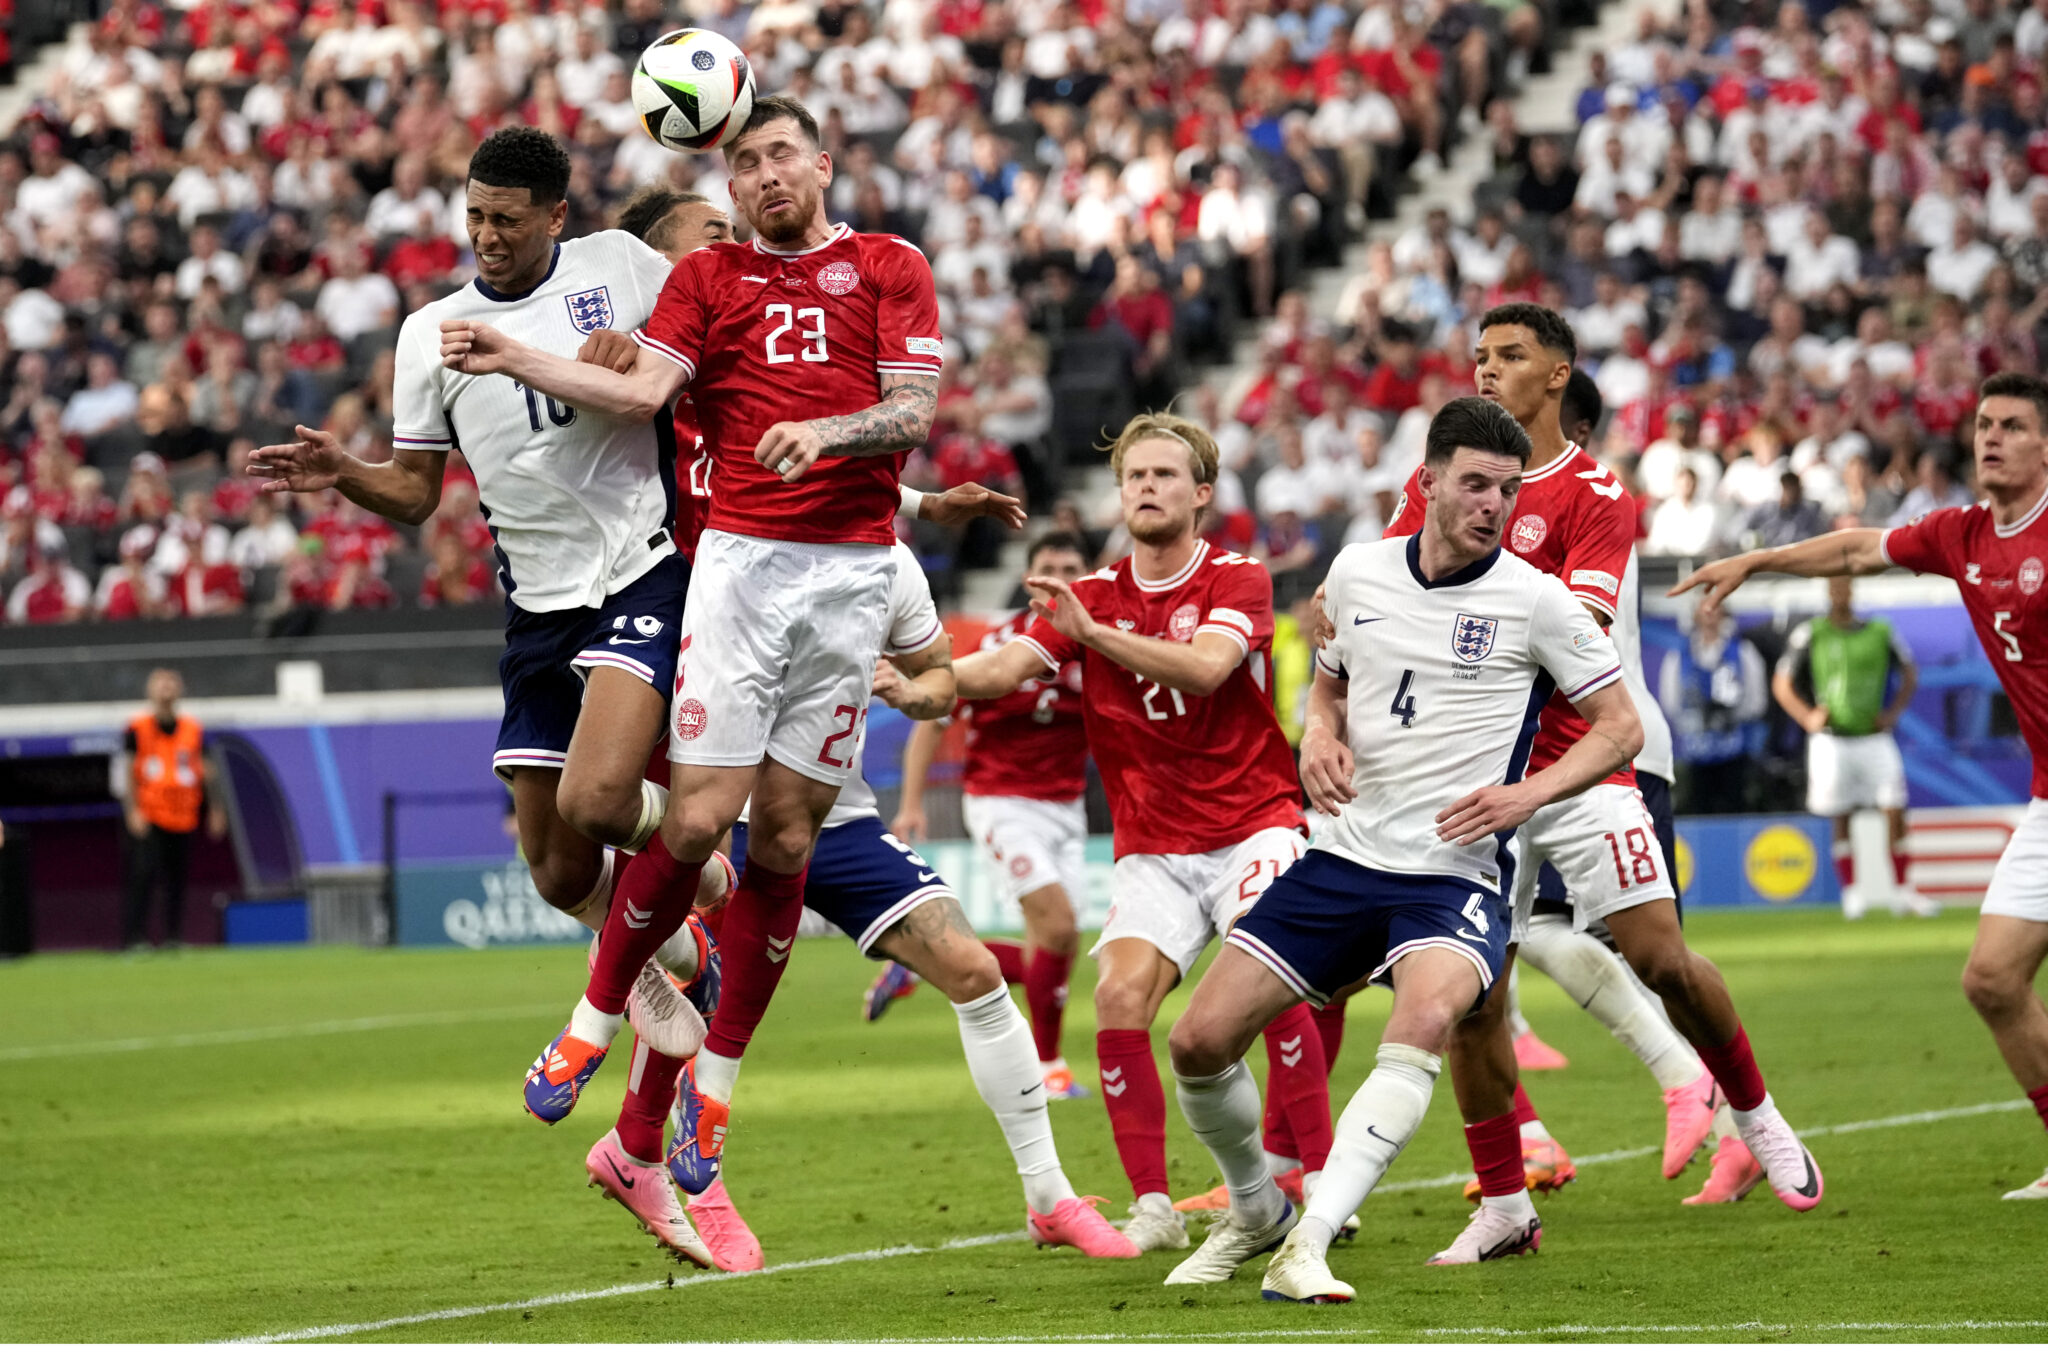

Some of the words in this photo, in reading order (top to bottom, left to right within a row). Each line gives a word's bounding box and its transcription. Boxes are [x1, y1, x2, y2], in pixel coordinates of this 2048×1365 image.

[826, 272, 850, 281] DBU
[765, 303, 829, 365] 23
[1518, 525, 1540, 541] DBU
[1993, 610, 2023, 662] 5
[681, 712, 700, 726] DBU
[1390, 668, 1418, 729] 4
[880, 833, 929, 868] 5
[1604, 827, 1658, 889] 18
[1461, 892, 1490, 935] 4
